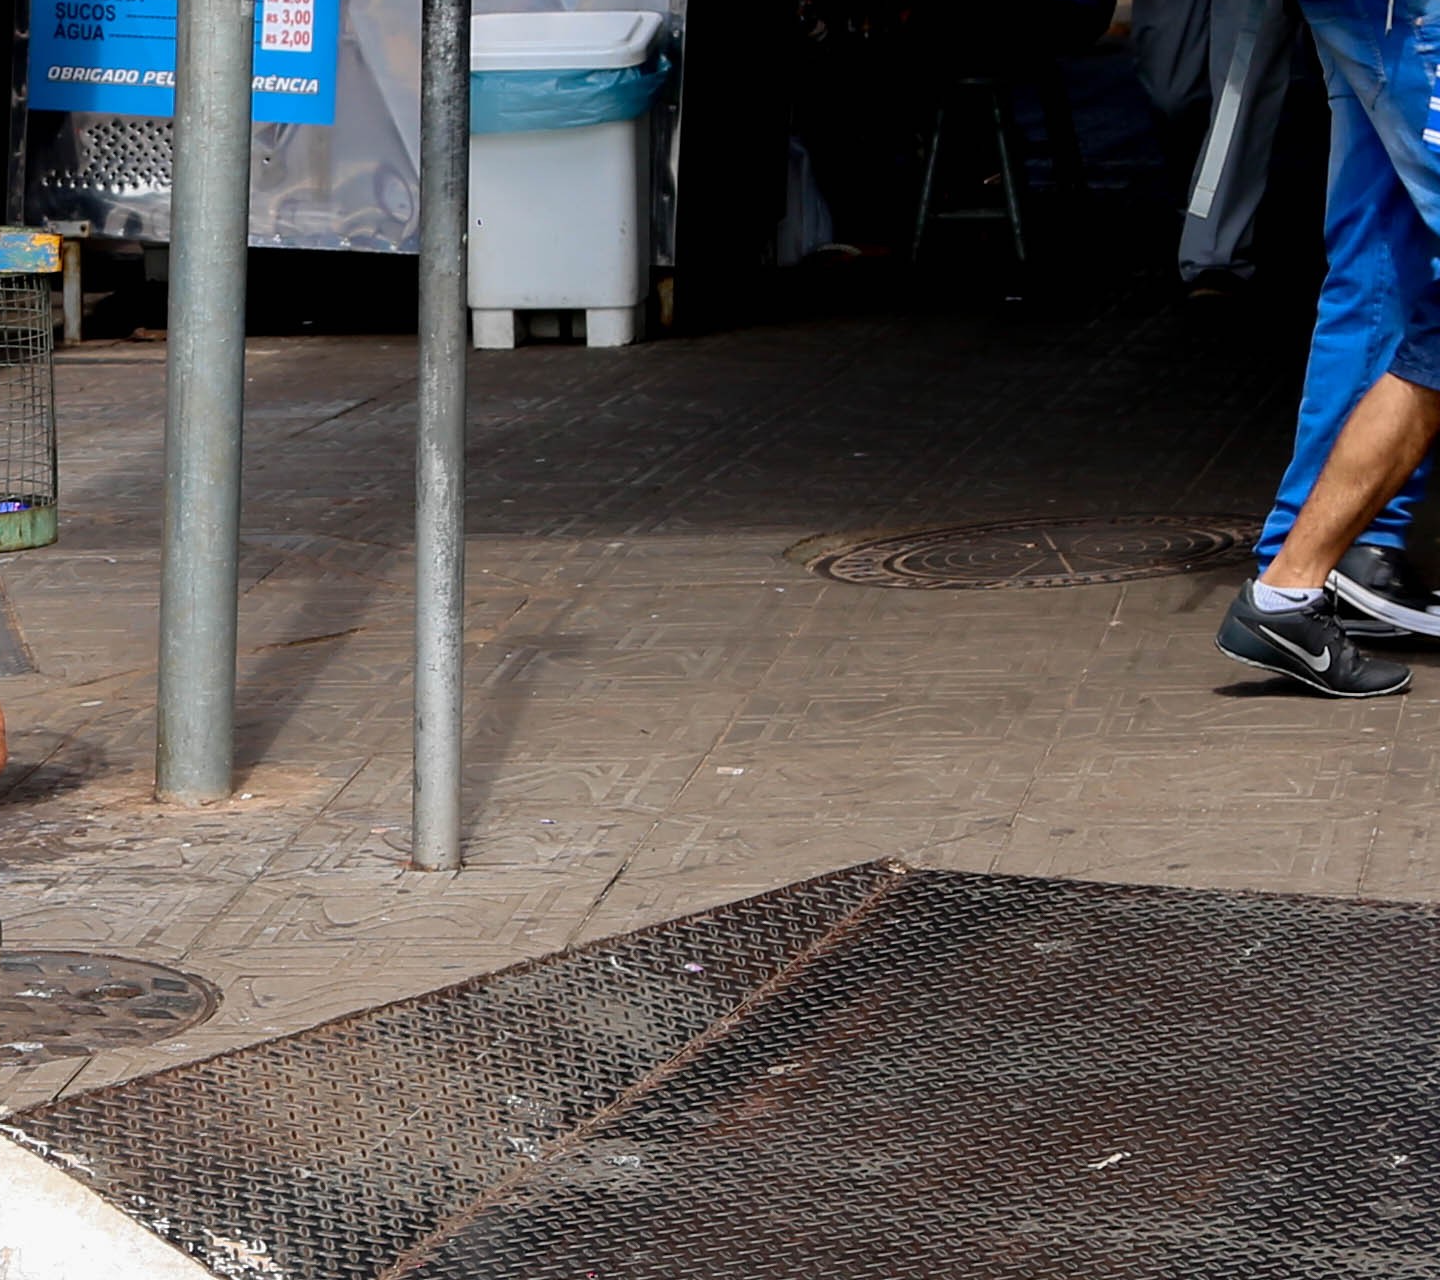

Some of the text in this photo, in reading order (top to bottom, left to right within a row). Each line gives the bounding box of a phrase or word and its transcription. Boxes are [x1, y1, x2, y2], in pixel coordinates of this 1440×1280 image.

[55, 2, 116, 21] SUCOS
[282, 9, 311, 27] 3,00
[281, 30, 310, 47] 2,00
[47, 66, 138, 85] OBRIGADO
